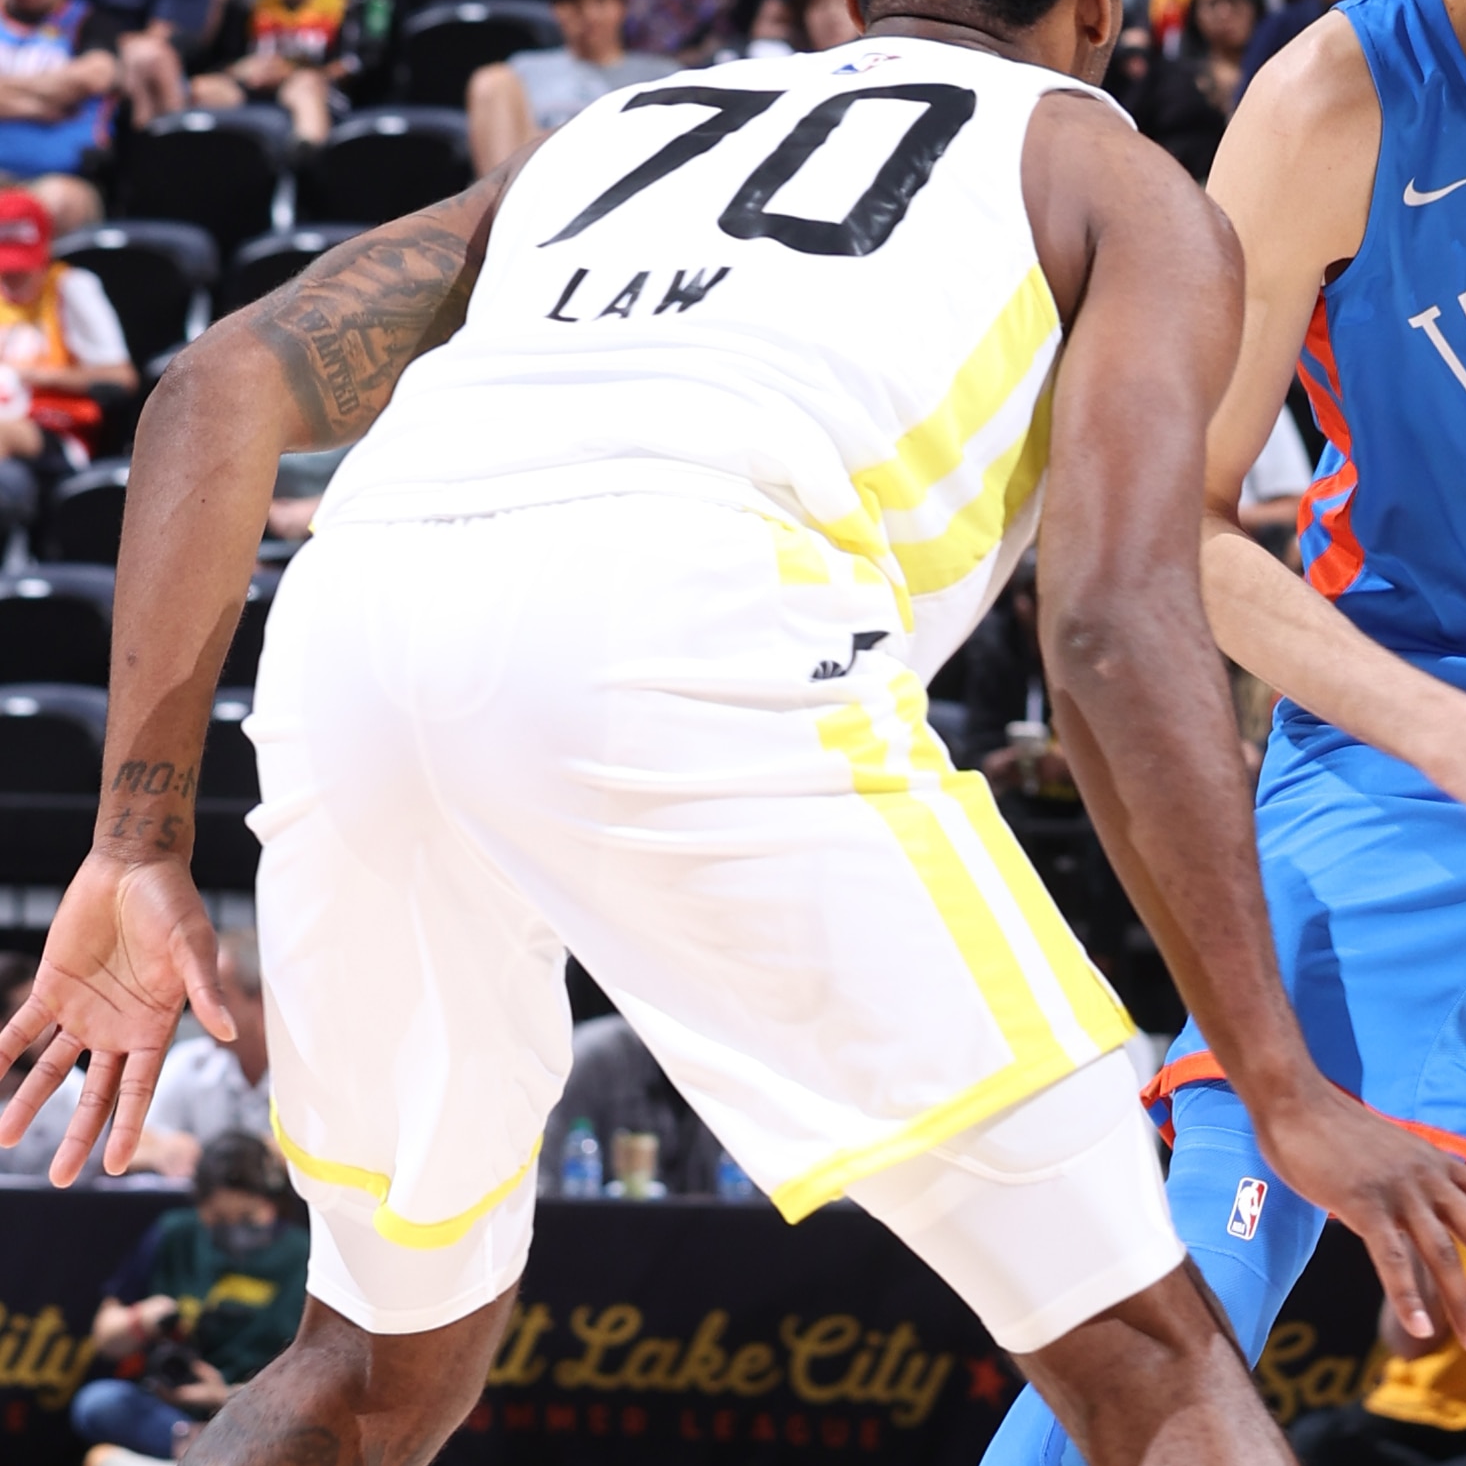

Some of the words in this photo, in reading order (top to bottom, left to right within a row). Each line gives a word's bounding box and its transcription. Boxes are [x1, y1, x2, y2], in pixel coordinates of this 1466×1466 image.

[536, 83, 977, 257] 70
[544, 266, 733, 323] LAW
[0, 1303, 98, 1411] ity
[553, 1302, 783, 1397] Lake
[780, 1313, 953, 1428] City
